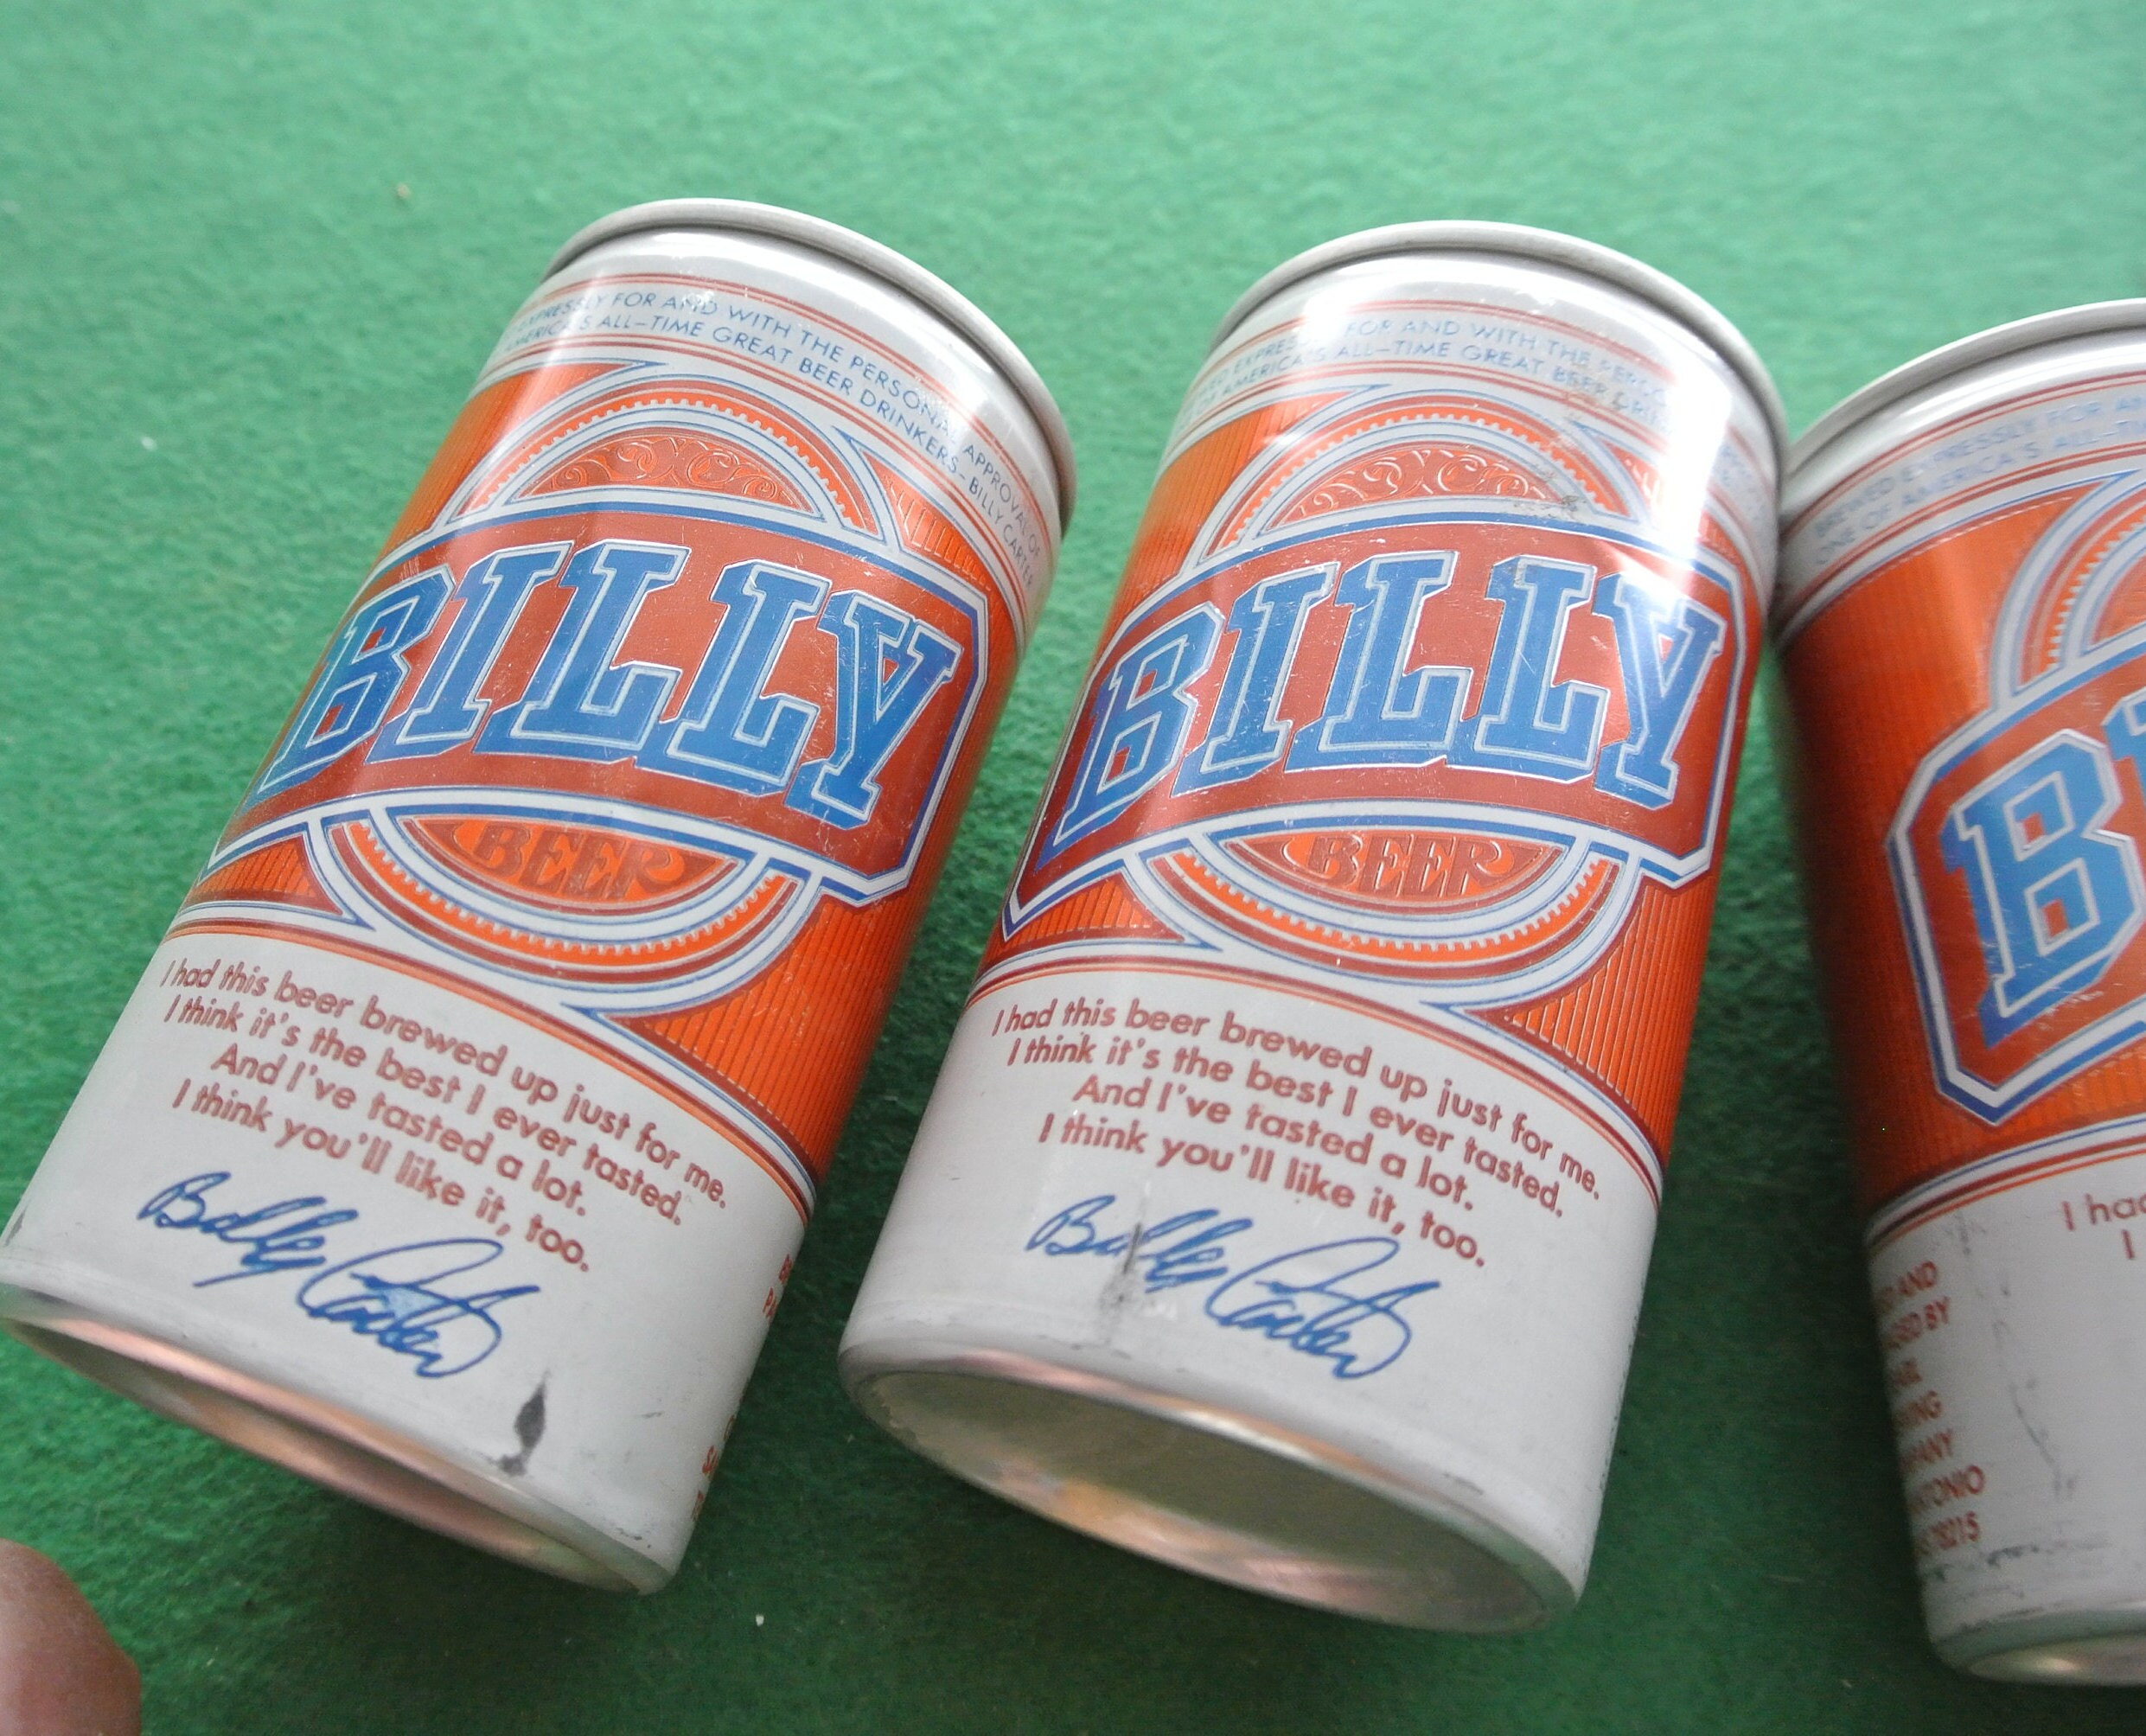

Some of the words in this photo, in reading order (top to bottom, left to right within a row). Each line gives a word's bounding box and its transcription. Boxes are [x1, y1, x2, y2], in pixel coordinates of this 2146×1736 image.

[597, 313, 705, 338] ALL-TIME
[712, 326, 794, 365] GREAT
[798, 356, 854, 397] BEER
[611, 291, 657, 308] FOR
[661, 292, 719, 316] AND
[729, 304, 792, 339] WITH
[800, 329, 845, 363] THE
[849, 354, 958, 445] PERSONA
[1332, 338, 1453, 359] ALL-TIME
[1461, 344, 1546, 375] GREAT
[1344, 318, 1393, 337] FOR
[1402, 319, 1461, 337] AND
[1470, 322, 1538, 351] WITH
[235, 539, 964, 832] BILLY
[1033, 550, 1729, 871] BILLY
[451, 821, 692, 899] BEER
[1280, 832, 1520, 897] BEER
[160, 960, 176, 987] I
[171, 958, 221, 988] had
[219, 961, 269, 997] this
[274, 970, 354, 1018] beer
[360, 994, 508, 1077] brewed
[511, 1066, 558, 1105] up
[563, 1084, 630, 1140] just
[635, 1122, 680, 1170] for
[684, 1163, 726, 1209] me.
[163, 994, 182, 1023] I
[177, 996, 244, 1032] think
[249, 1006, 301, 1047] it's
[309, 1026, 367, 1068] the
[376, 1047, 462, 1104] best
[466, 1084, 486, 1115] I
[493, 1107, 577, 1158] ever
[583, 1143, 682, 1226] tasted.
[210, 1043, 288, 1085] And
[286, 1062, 357, 1110] I've
[367, 1091, 495, 1166] tasted
[496, 1155, 524, 1181] a
[532, 1159, 586, 1216] lot.
[992, 1010, 1005, 1037] I
[1005, 998, 1057, 1033] had
[1062, 996, 1116, 1027] this
[1125, 998, 1210, 1037] beer
[1219, 1010, 1372, 1078] brewed
[1380, 1065, 1427, 1102] up
[1436, 1079, 1503, 1132] just
[1511, 1112, 1554, 1160] for
[1559, 1152, 1600, 1200] me.
[1007, 1037, 1021, 1066] I
[1024, 1034, 1096, 1064] think
[1106, 1037, 1160, 1069] it's
[1172, 1046, 1234, 1082] the
[1246, 1058, 1332, 1108] best
[1342, 1086, 1358, 1117] I
[1370, 1106, 1454, 1152] ever
[1463, 1136, 1562, 1217] tasted.
[1073, 1074, 1153, 1107] And
[1156, 1082, 1231, 1124] I've
[1245, 1103, 1373, 1165] tasted
[1381, 1153, 1407, 1178] a
[1416, 1155, 1473, 1210] lot.
[172, 1078, 191, 1108] I
[191, 1082, 272, 1132] think
[274, 1118, 392, 1174] you'll
[395, 1150, 466, 1207] like
[475, 1187, 512, 1236] it,
[526, 1214, 589, 1272] too.
[1038, 1113, 1055, 1143] I
[1060, 1114, 1148, 1154] think
[1156, 1137, 1275, 1183] you'll
[1284, 1156, 1356, 1209] like
[1368, 1186, 1405, 1235] it,
[1421, 1210, 1485, 1267] too.
